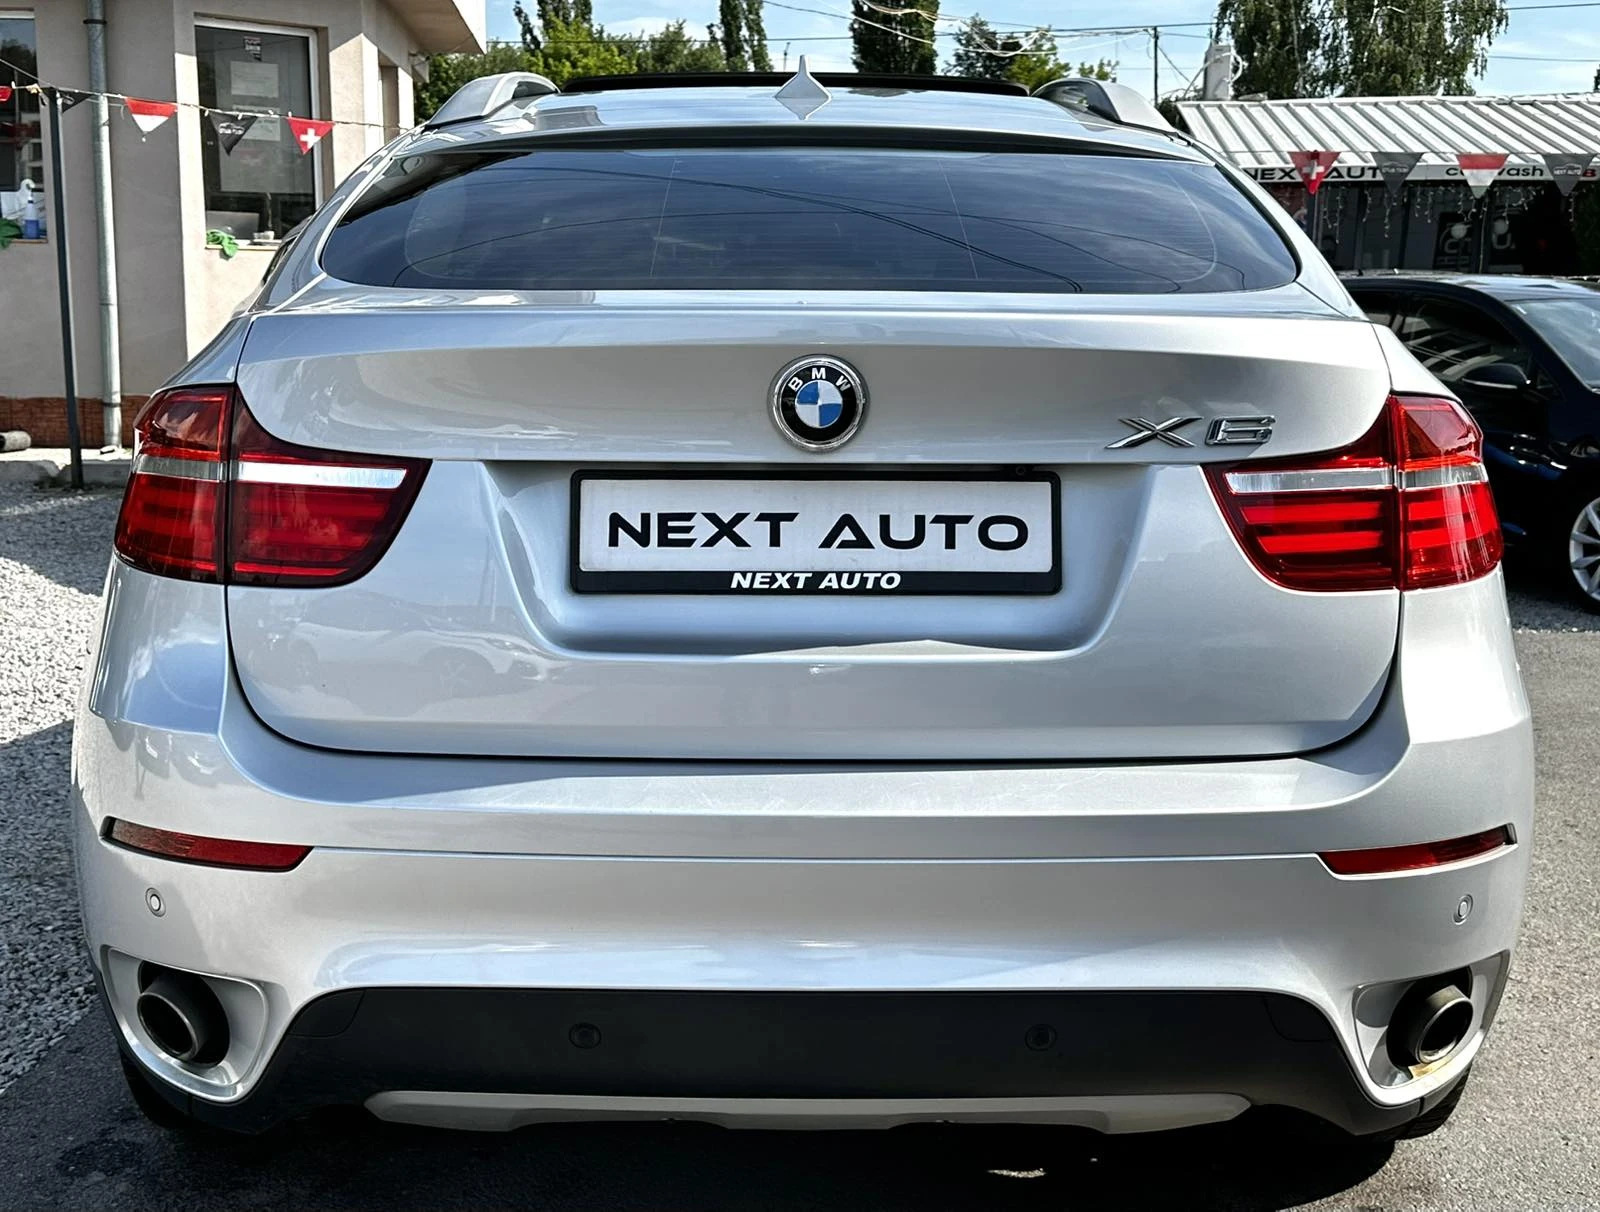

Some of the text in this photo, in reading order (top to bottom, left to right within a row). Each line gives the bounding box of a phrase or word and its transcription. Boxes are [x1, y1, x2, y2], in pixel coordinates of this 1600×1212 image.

[1242, 167, 1297, 181] NEX
[1323, 166, 1381, 179] AUT
[788, 367, 851, 392] BMW
[1104, 414, 1276, 449] X6
[608, 511, 1029, 551] NEXT AUTO
[730, 572, 901, 590] NEXT AUTO
